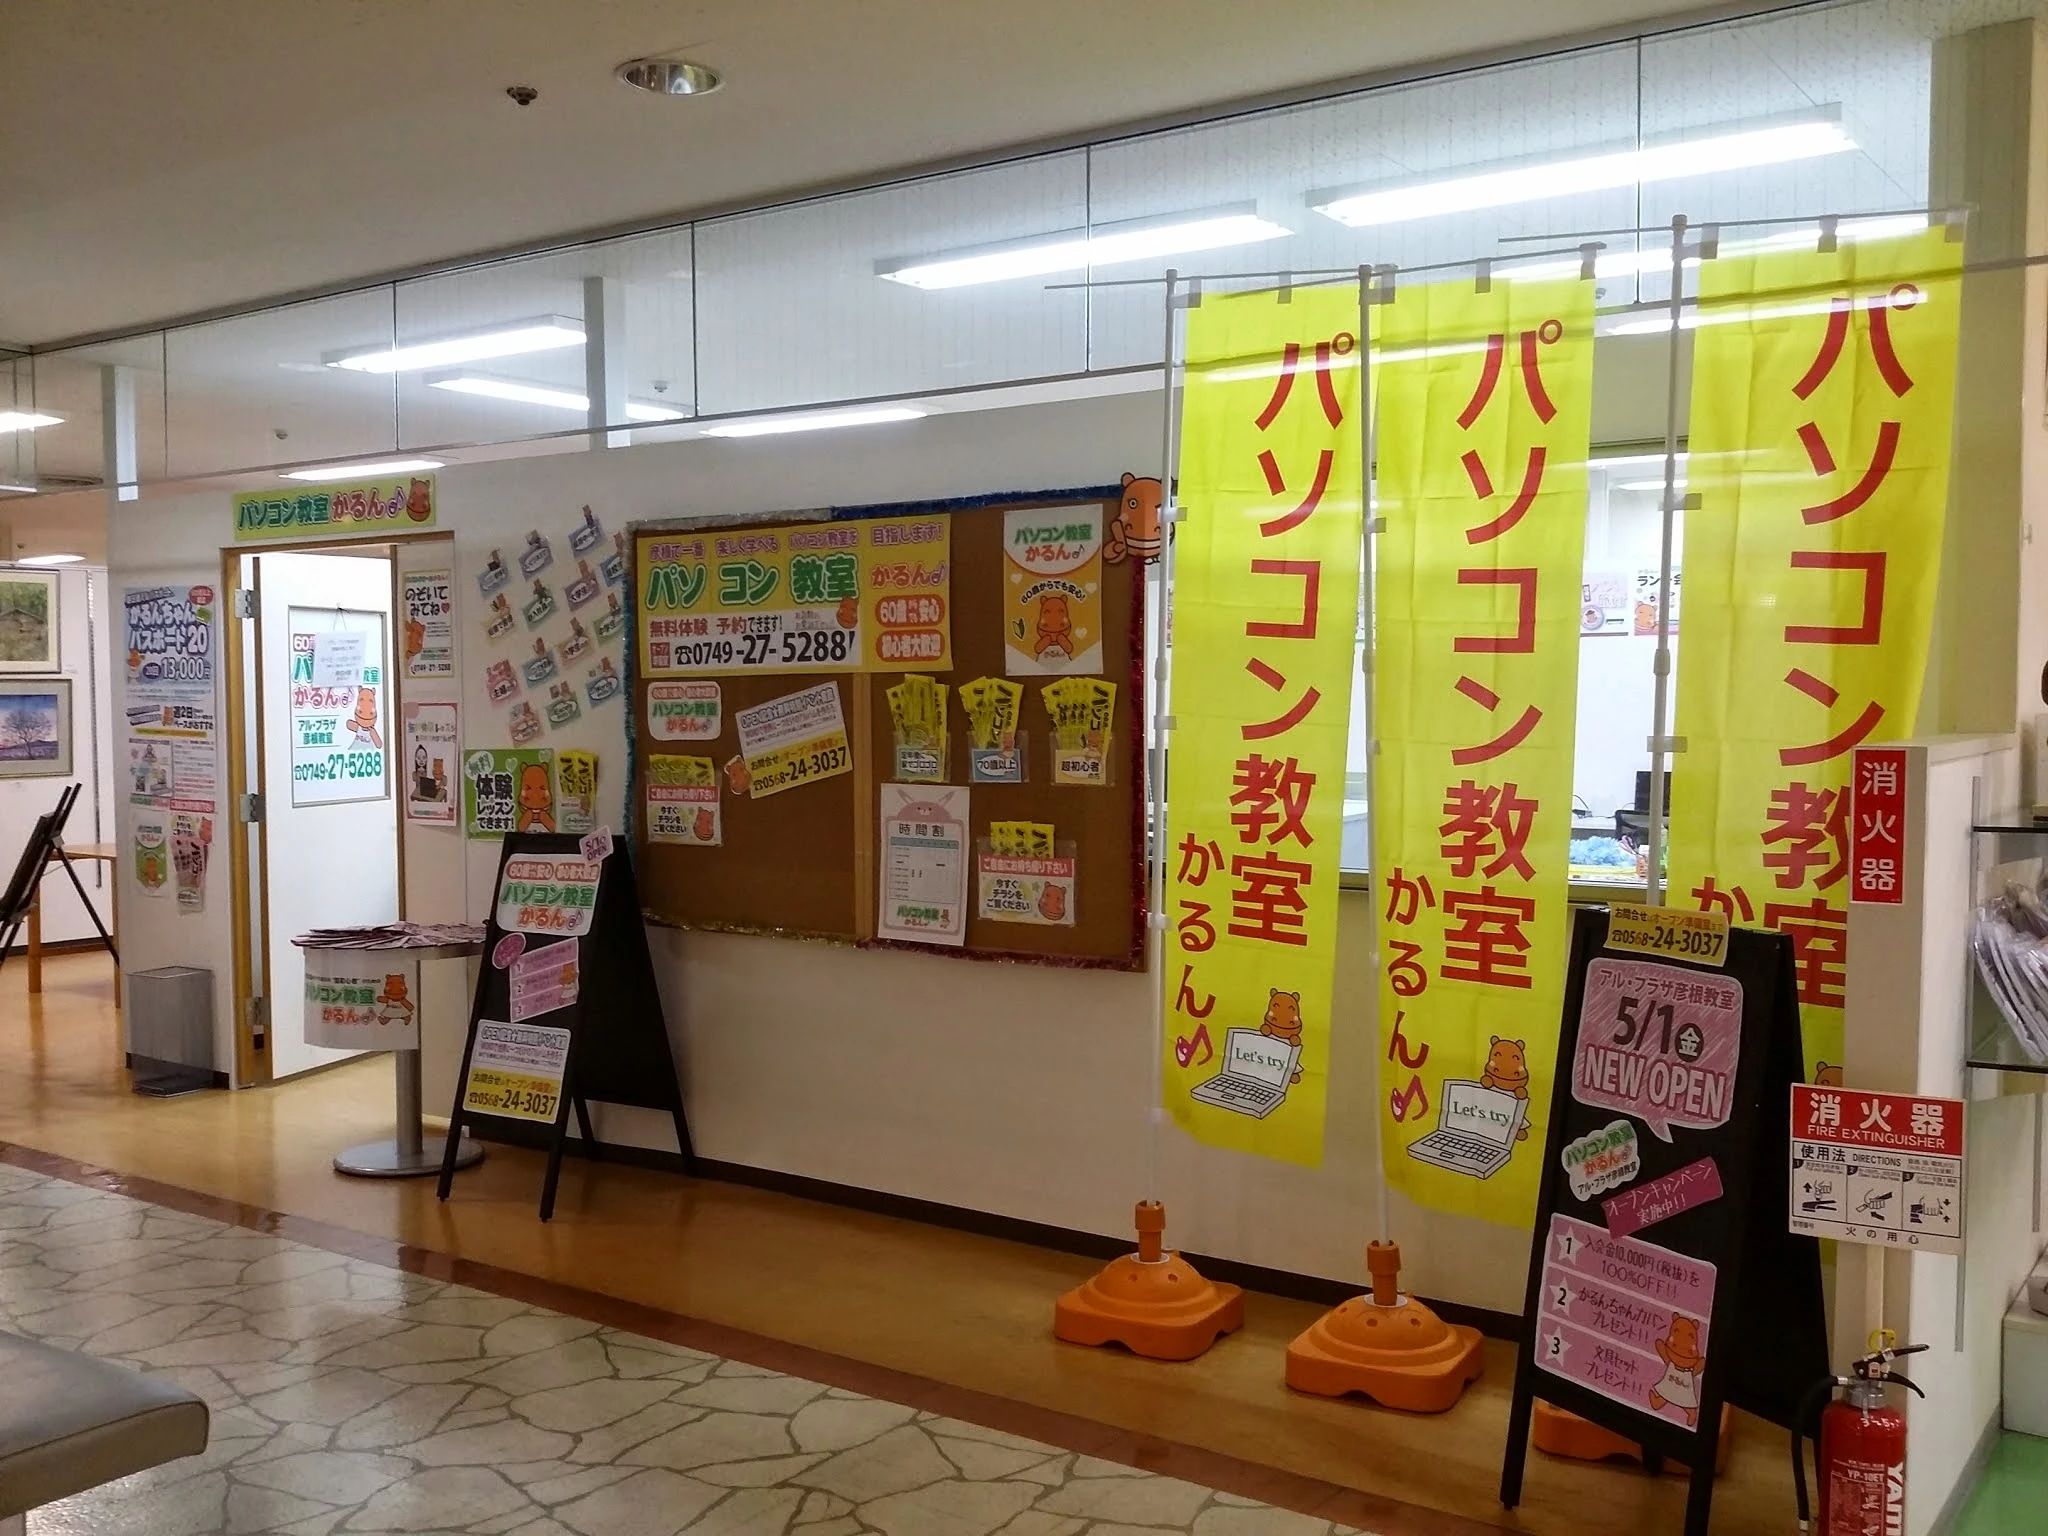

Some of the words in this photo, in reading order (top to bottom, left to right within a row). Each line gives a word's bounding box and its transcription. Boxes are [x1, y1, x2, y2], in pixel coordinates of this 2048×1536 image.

[239, 495, 330, 530] パソコン教室
[1014, 524, 1092, 544] パソコン教室
[647, 565, 706, 608] パソ
[721, 562, 778, 604] コン
[791, 553, 858, 603] 教室
[405, 586, 448, 601] のぞいて
[410, 602, 440, 616] みてね
[651, 618, 708, 637] 無料体験
[717, 615, 782, 635] 予約できます!
[1227, 332, 1354, 946] パソコン教室
[1440, 319, 1562, 989] パソコン教室
[652, 702, 717, 718] パソコン教室
[762, 746, 846, 789] 0568-24-3037
[1062, 761, 1100, 772] 超初心者
[476, 773, 513, 800] 体験
[477, 802, 514, 815] レッスン
[477, 818, 514, 830] できます!
[899, 823, 944, 838] 時間割
[1860, 761, 1897, 892] 消火器
[503, 884, 594, 906] パソコン教室
[1175, 833, 1226, 1018] かるん
[1615, 908, 1648, 922] お問合せ
[1622, 926, 1723, 957] 0568-24-3037
[1386, 867, 1436, 1069] かるん
[1613, 996, 1674, 1055] 5/1
[1234, 1047, 1265, 1065] Let's
[1266, 1055, 1286, 1071] try
[1584, 1045, 1647, 1100] NEW
[1649, 1060, 1727, 1121] OPEN
[1452, 1100, 1487, 1120] Let's
[1489, 1110, 1511, 1127] try
[1810, 1092, 1944, 1136] 消火器
[1567, 1126, 1634, 1166] パソコン教室
[1808, 1125, 1837, 1138] FIRE
[1842, 1128, 1945, 1149] EXTINGUISHER
[1801, 1144, 1846, 1162] 使用法
[1852, 1153, 1902, 1167] DIRECTIONS
[1608, 1165, 1712, 1216] オープンキャンペーン
[1846, 1227, 1919, 1245] 火の用心
[1557, 1287, 1567, 1306] 2
[1552, 1336, 1561, 1355] 3
